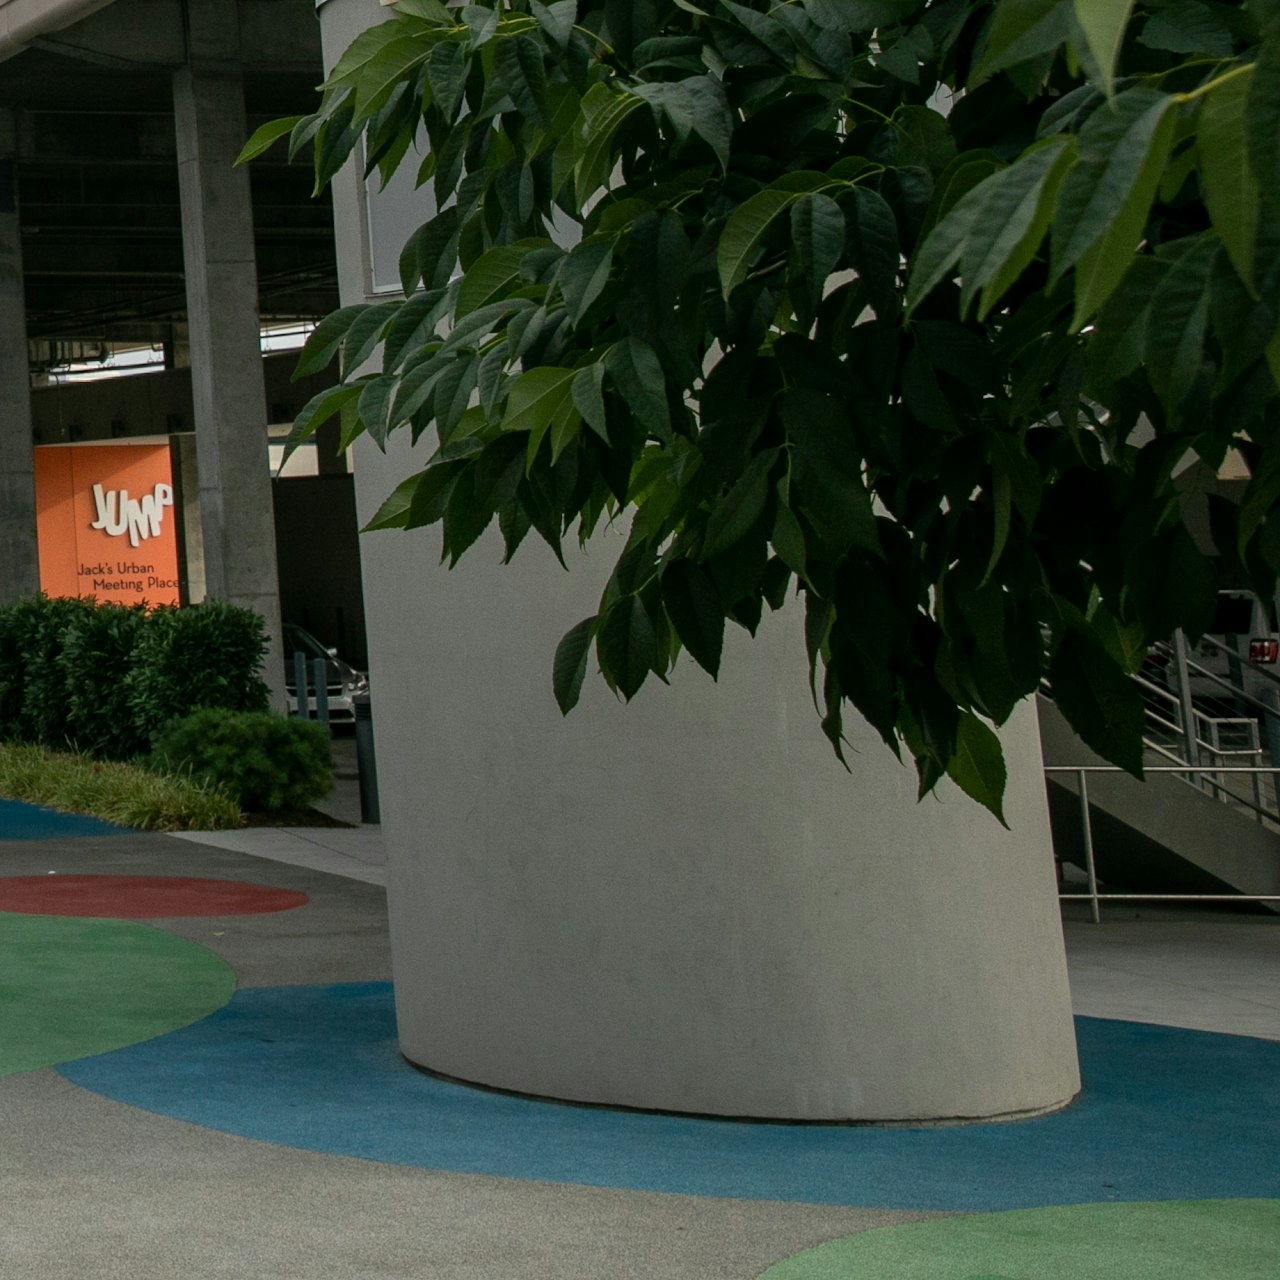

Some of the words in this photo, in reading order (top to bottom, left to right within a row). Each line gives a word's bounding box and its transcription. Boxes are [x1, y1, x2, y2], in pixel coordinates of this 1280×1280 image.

[91, 483, 174, 548] JUMP
[77, 562, 113, 576] Jack's
[117, 562, 154, 574] Urban
[93, 579, 144, 592] Meeting
[147, 576, 180, 589] Place
